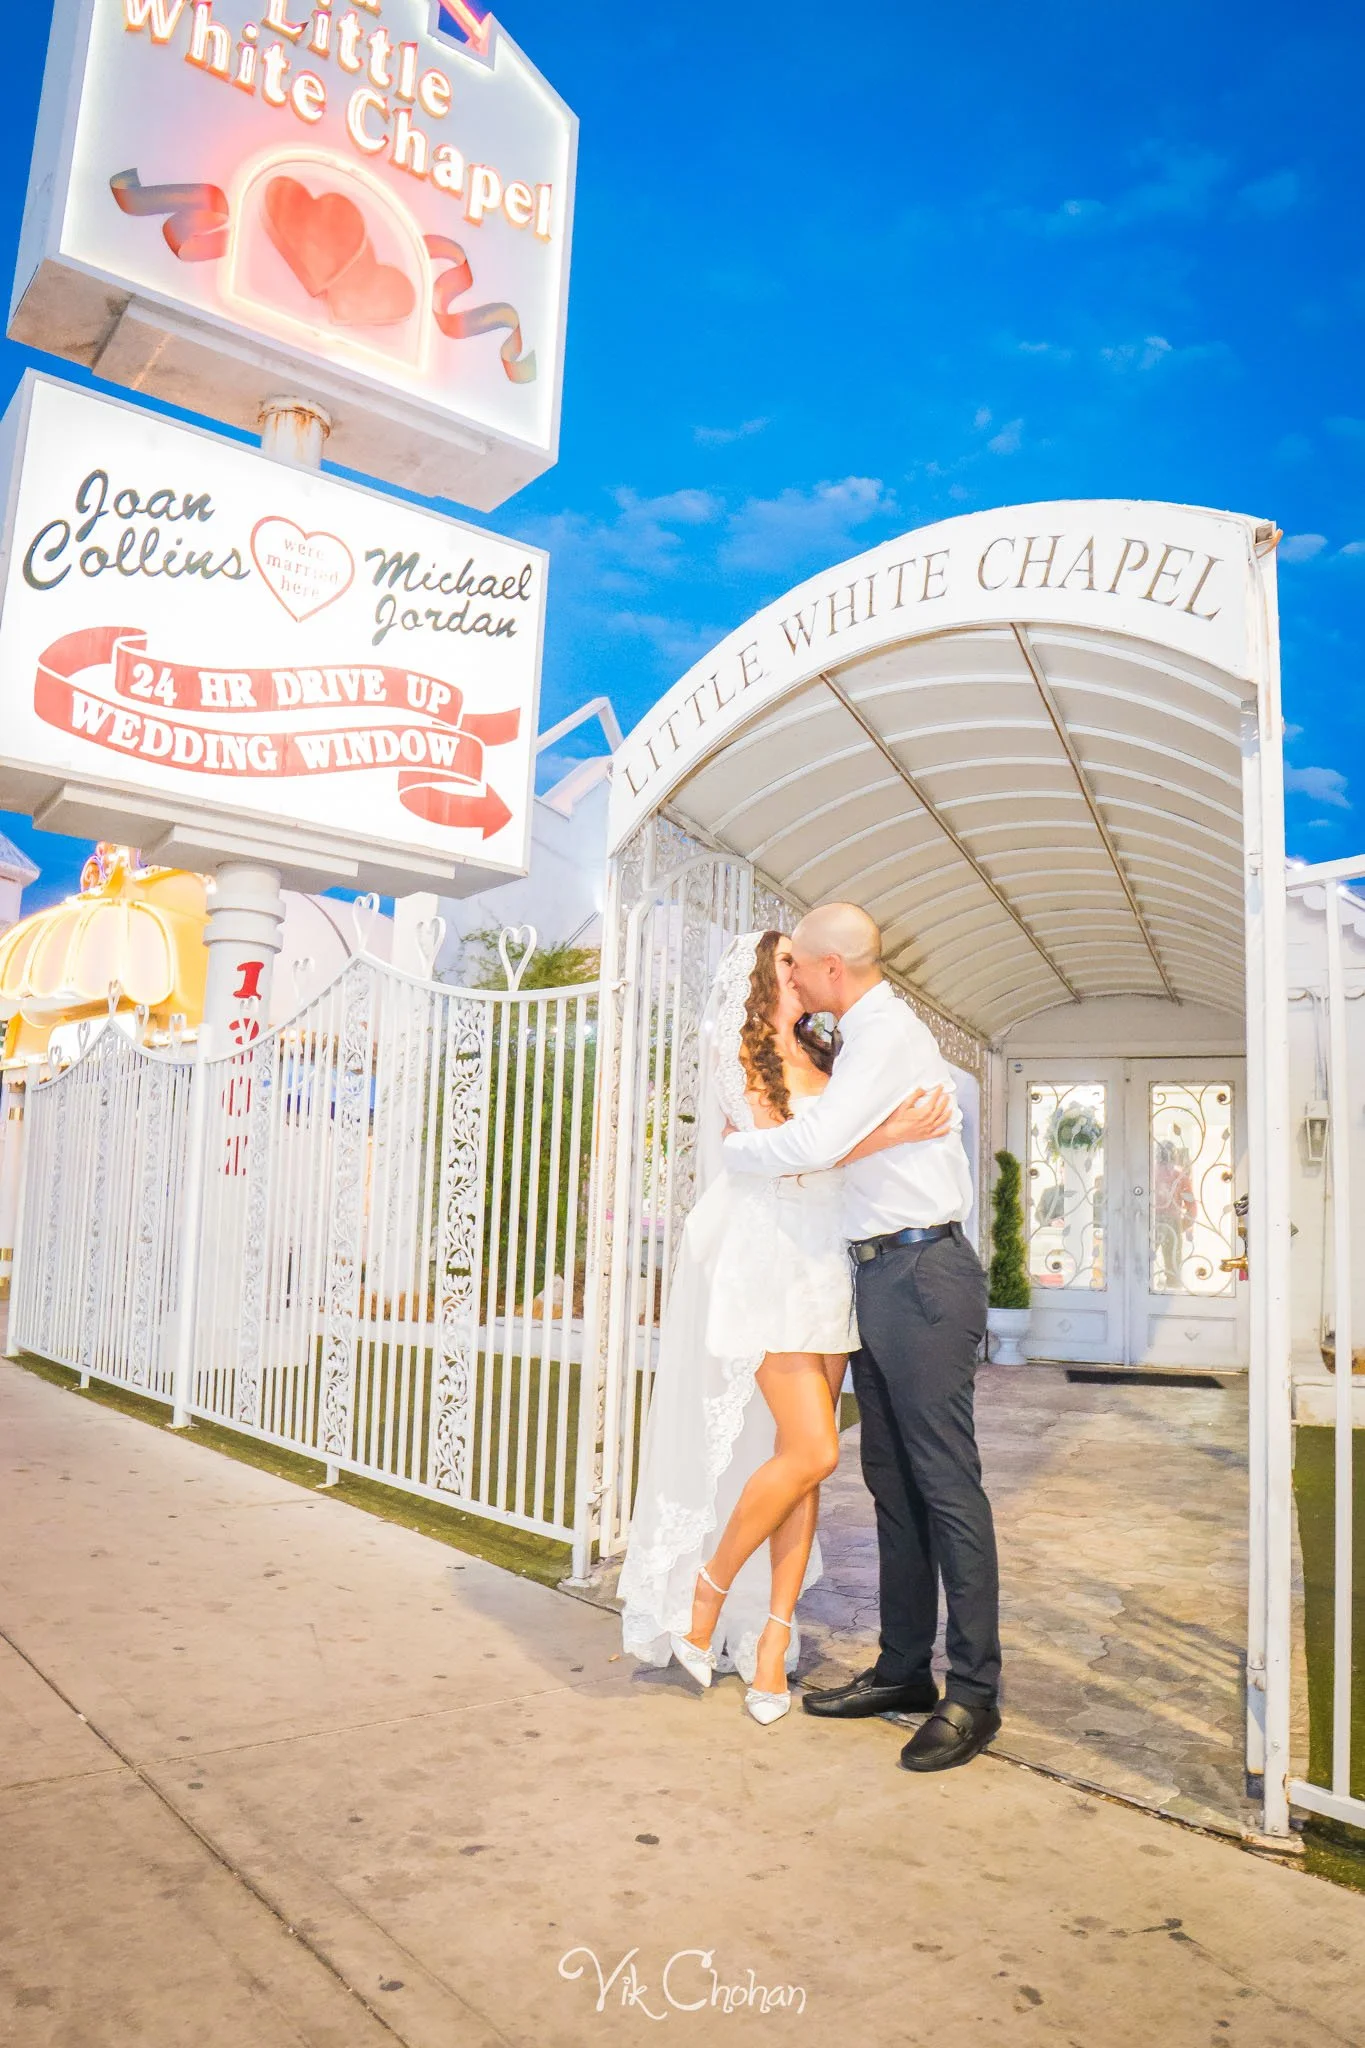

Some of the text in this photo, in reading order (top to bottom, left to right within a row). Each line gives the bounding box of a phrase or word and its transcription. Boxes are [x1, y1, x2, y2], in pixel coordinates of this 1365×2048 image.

[261, 0, 453, 118] Little
[123, 0, 554, 244] White Chapel
[75, 469, 216, 543] Joan
[22, 519, 251, 590] Collins
[364, 548, 532, 601] Michael
[371, 593, 518, 646] Jordan
[130, 662, 452, 715] 24 HR DRIVE UP
[618, 535, 1225, 799] LITTLE WHITE CHAPEL
[71, 690, 460, 772] WEDDING WINDOW
